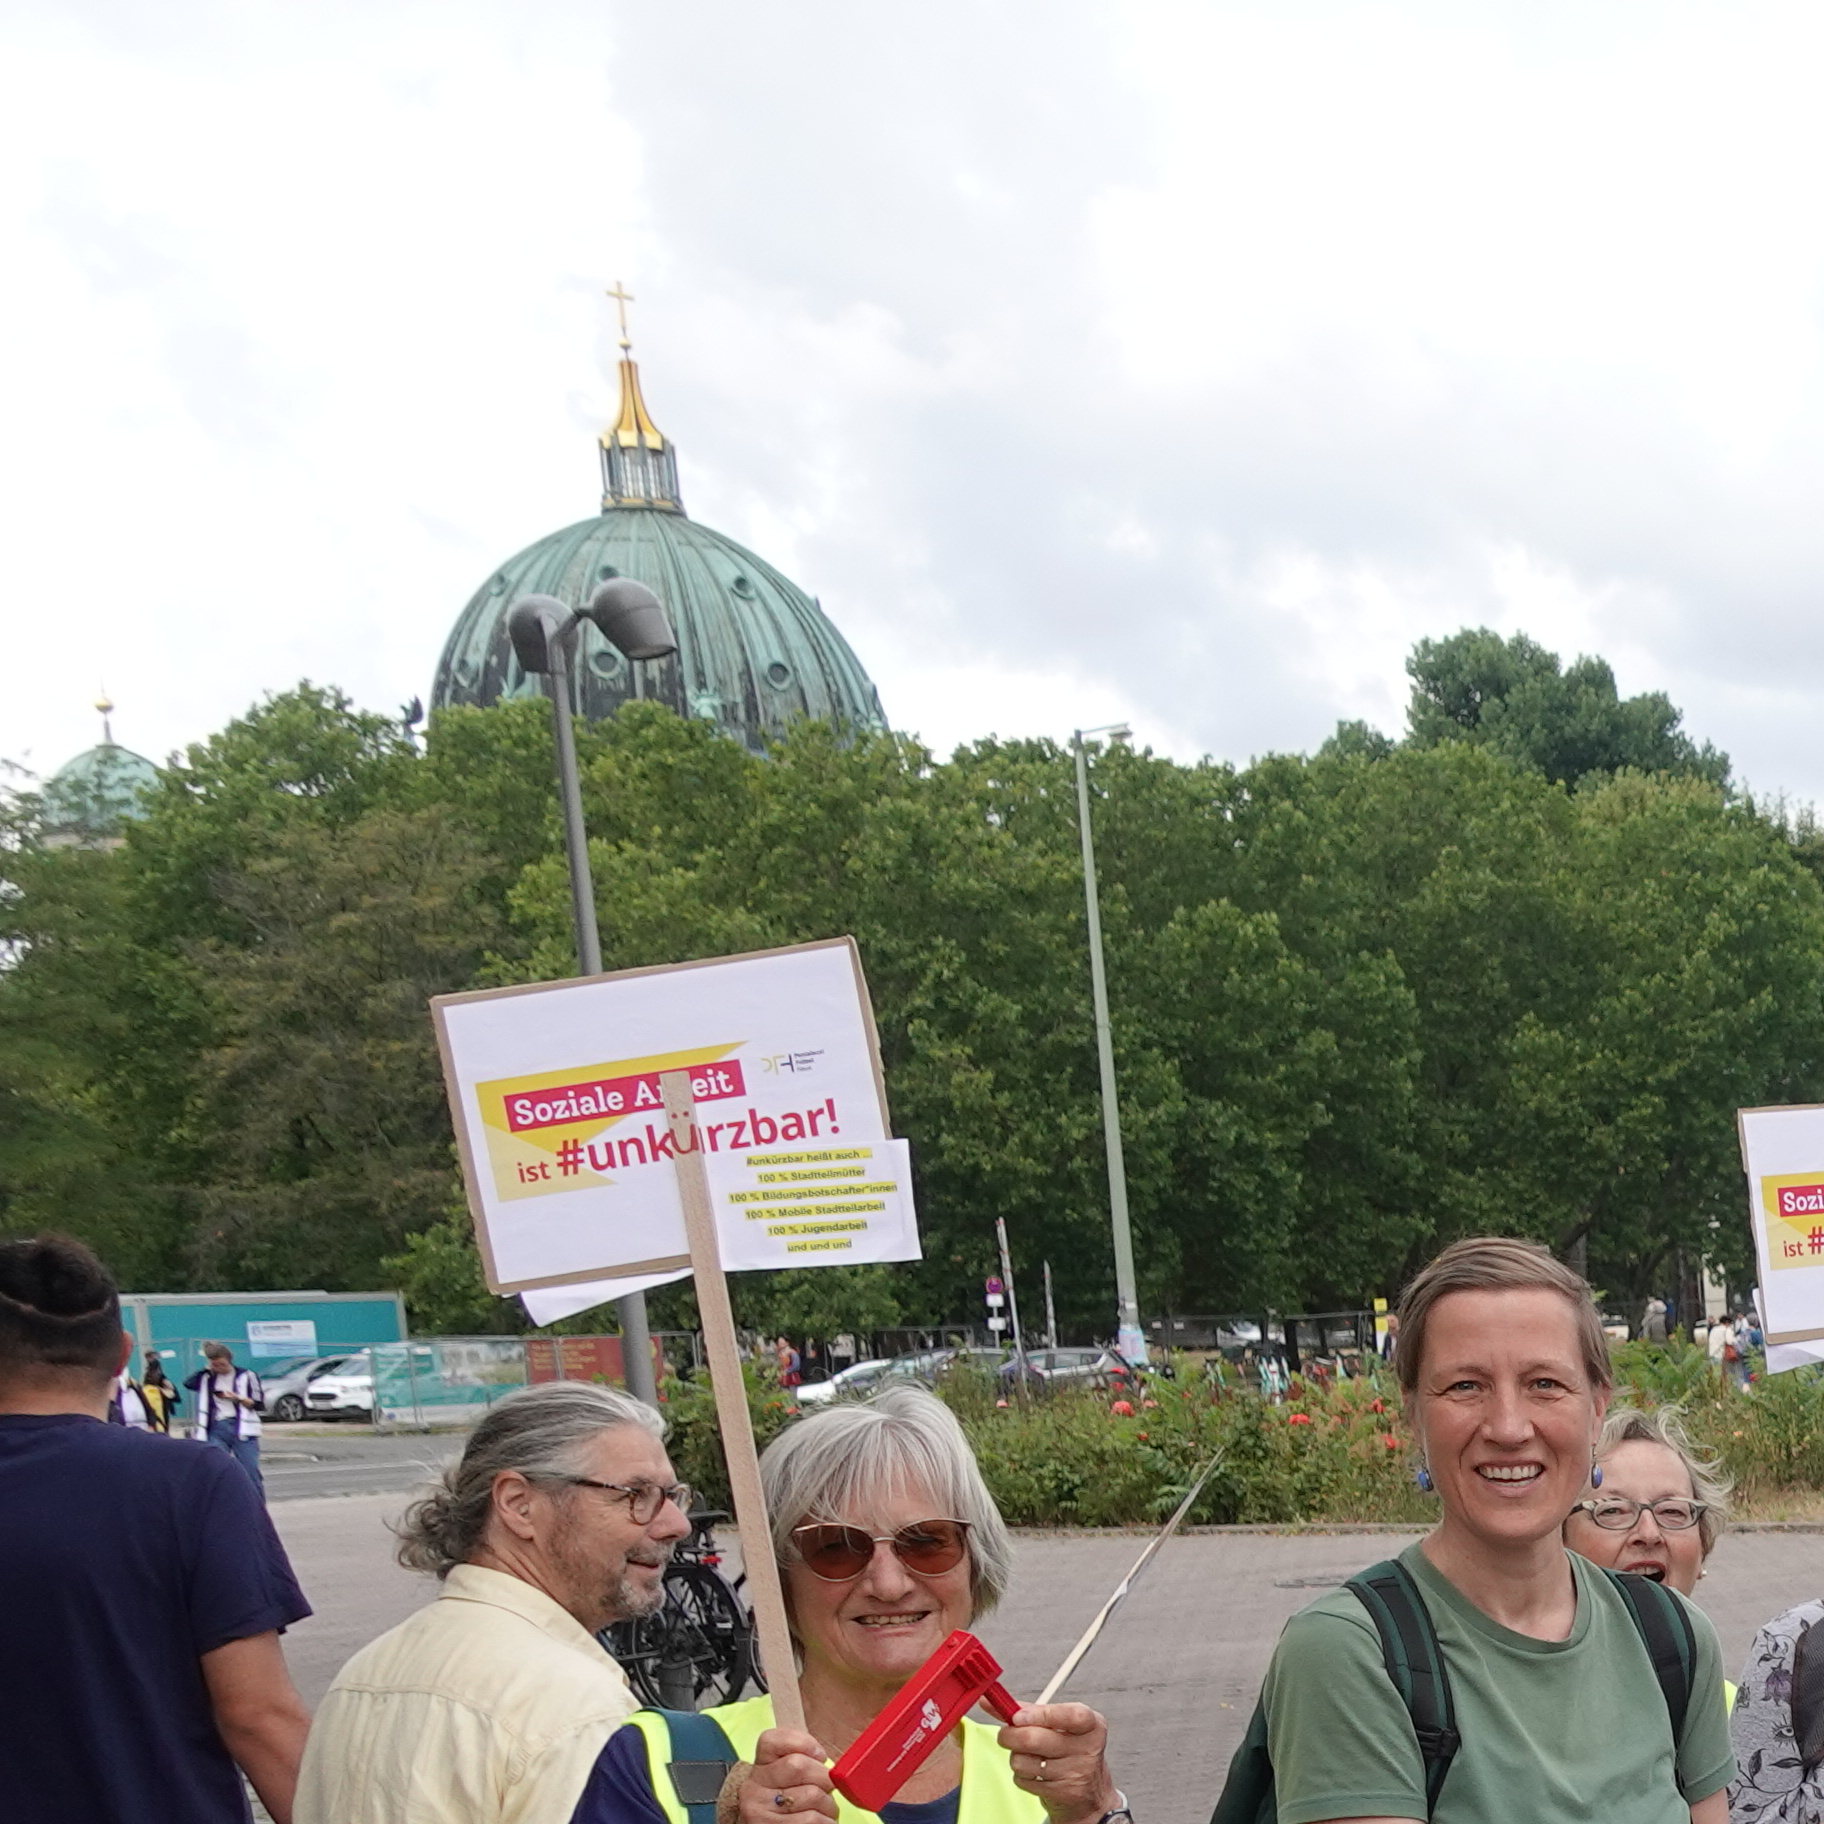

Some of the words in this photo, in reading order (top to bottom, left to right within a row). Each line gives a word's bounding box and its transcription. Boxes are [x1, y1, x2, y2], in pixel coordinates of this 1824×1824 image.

[514, 1087, 623, 1124] Soziale
[517, 1161, 552, 1183] ist
[1783, 1241, 1804, 1257] ist
